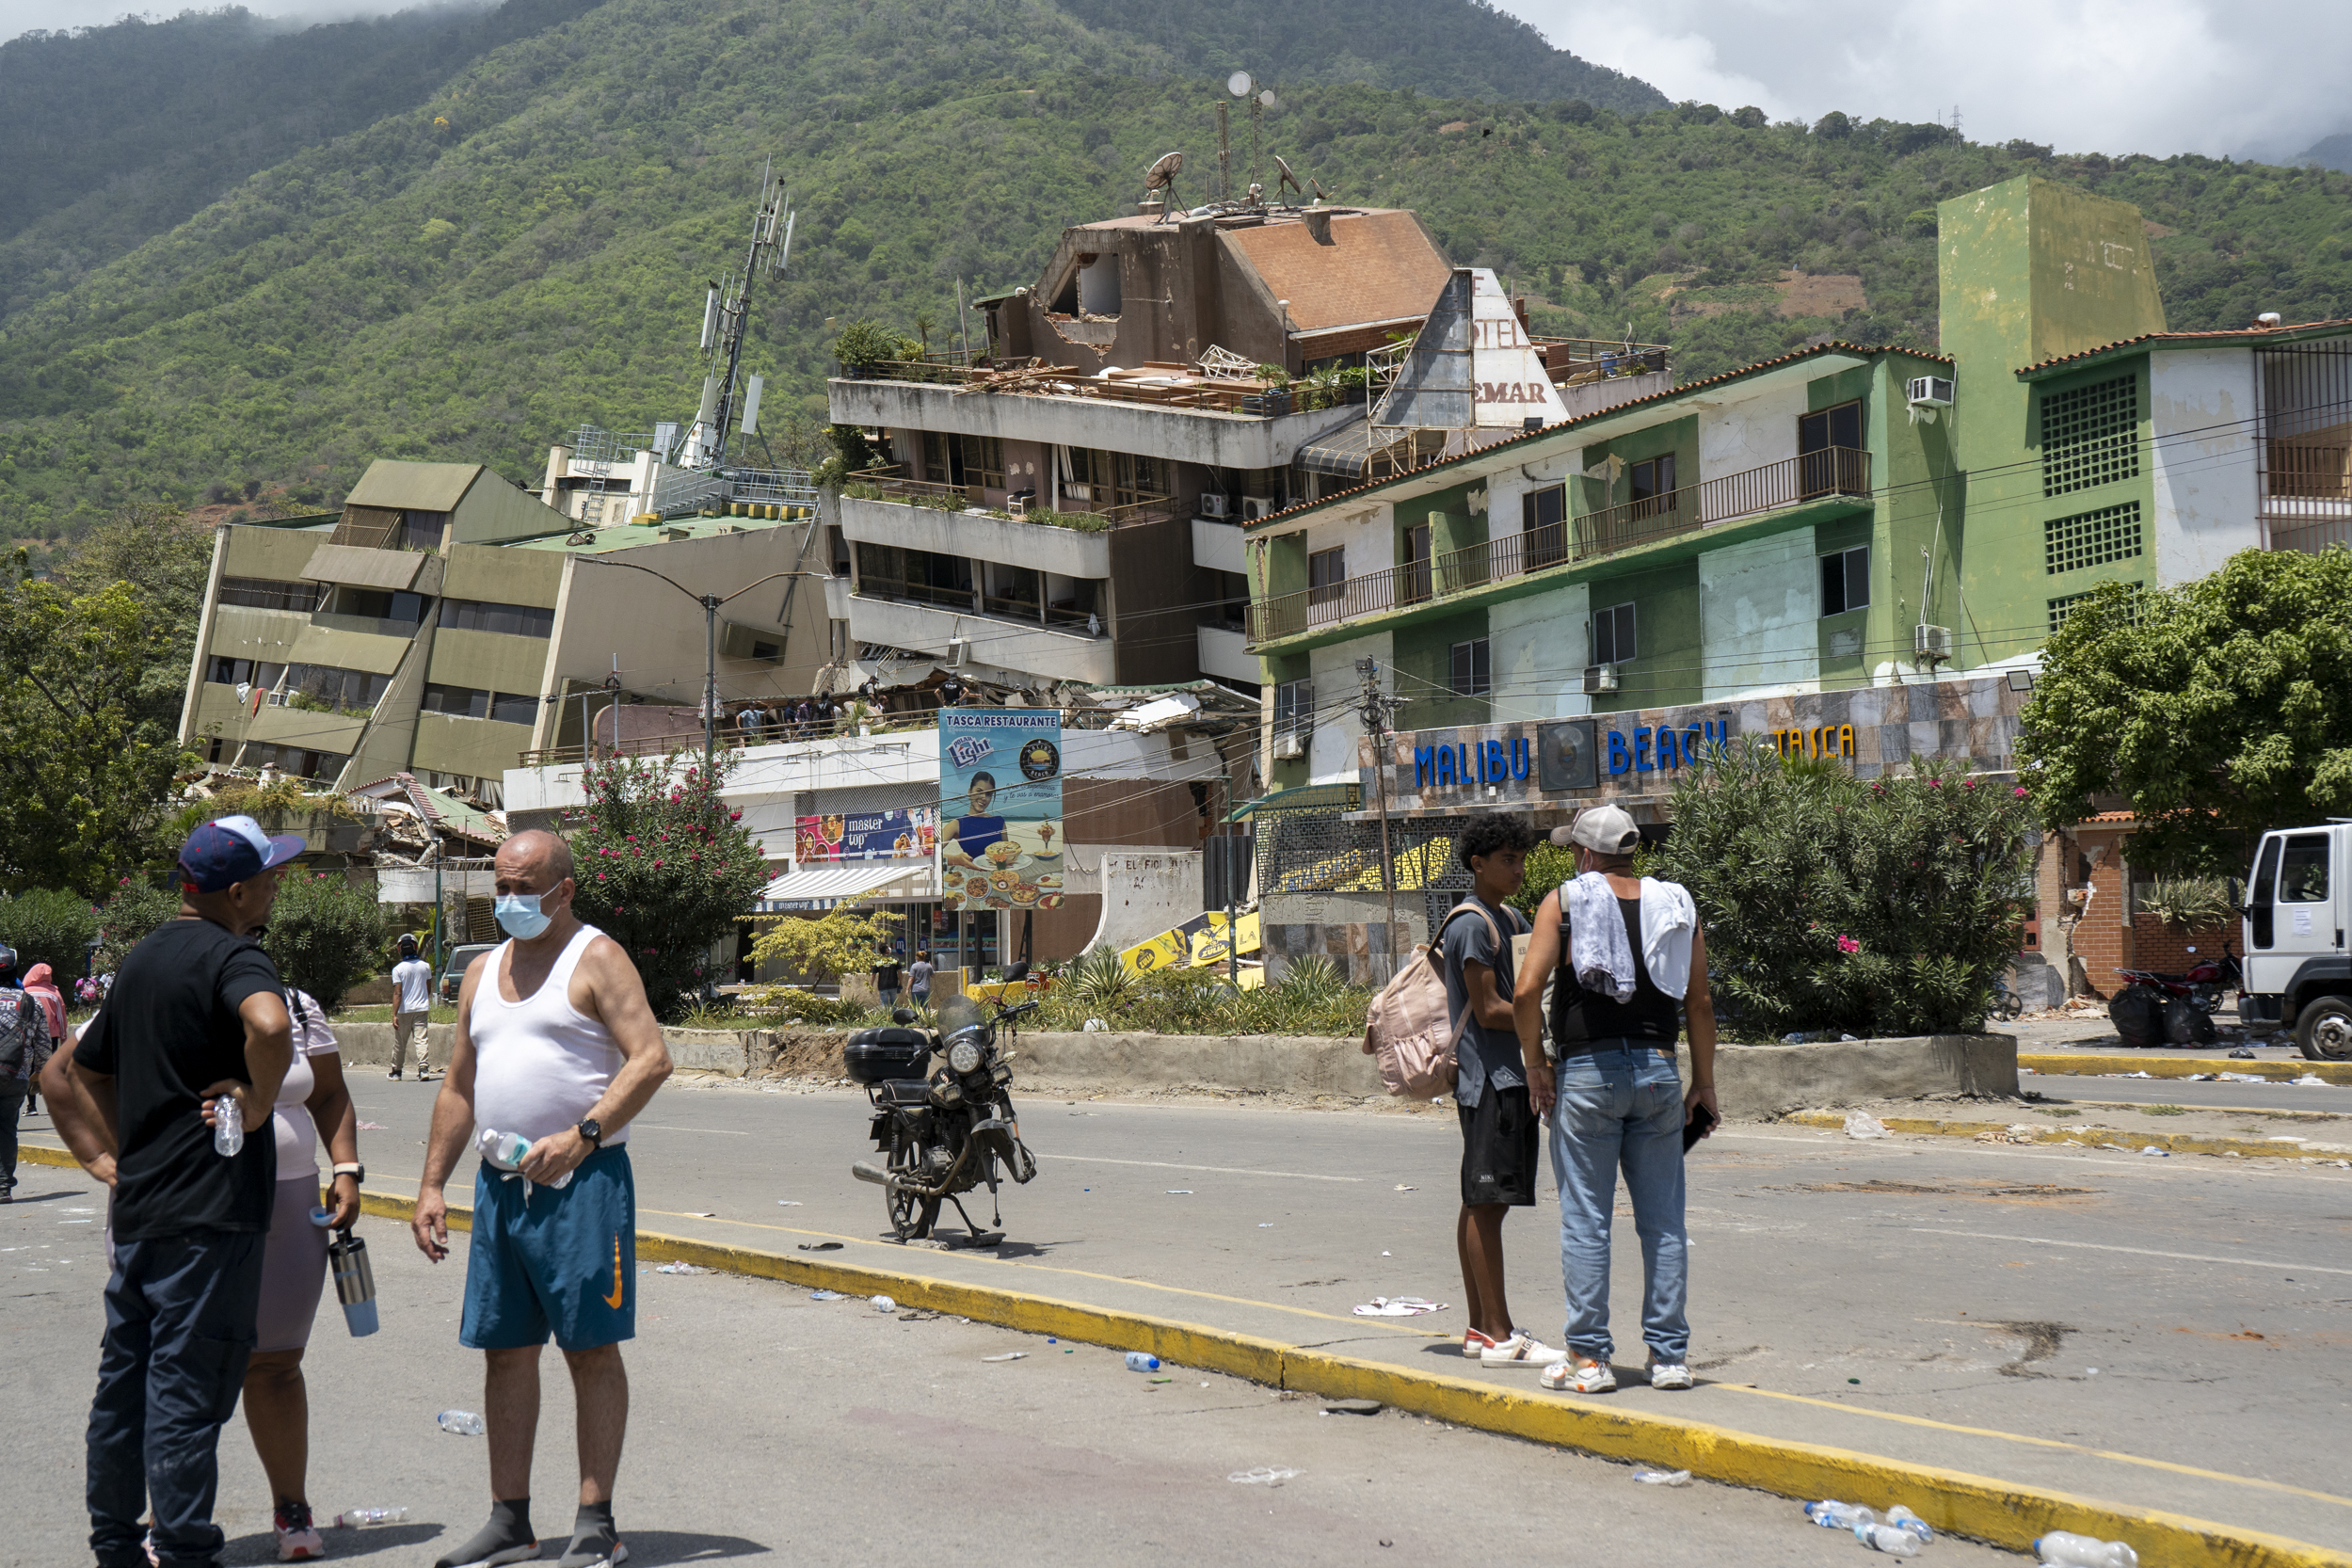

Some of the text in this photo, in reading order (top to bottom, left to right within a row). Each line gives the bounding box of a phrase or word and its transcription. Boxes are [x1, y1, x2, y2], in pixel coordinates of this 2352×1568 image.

[946, 715, 1057, 727] TASCA RESTAURANTE
[953, 736, 973, 748] POLAR
[1773, 723, 1854, 760] TASCA
[949, 739, 990, 767] Light
[1415, 719, 1728, 788] MALIBU BEACH
[848, 818, 883, 832] master
[848, 832, 865, 849] top
[778, 902, 798, 910] master
[1201, 944, 1226, 957] ZULIA
[1139, 952, 1155, 969] ZULIA
